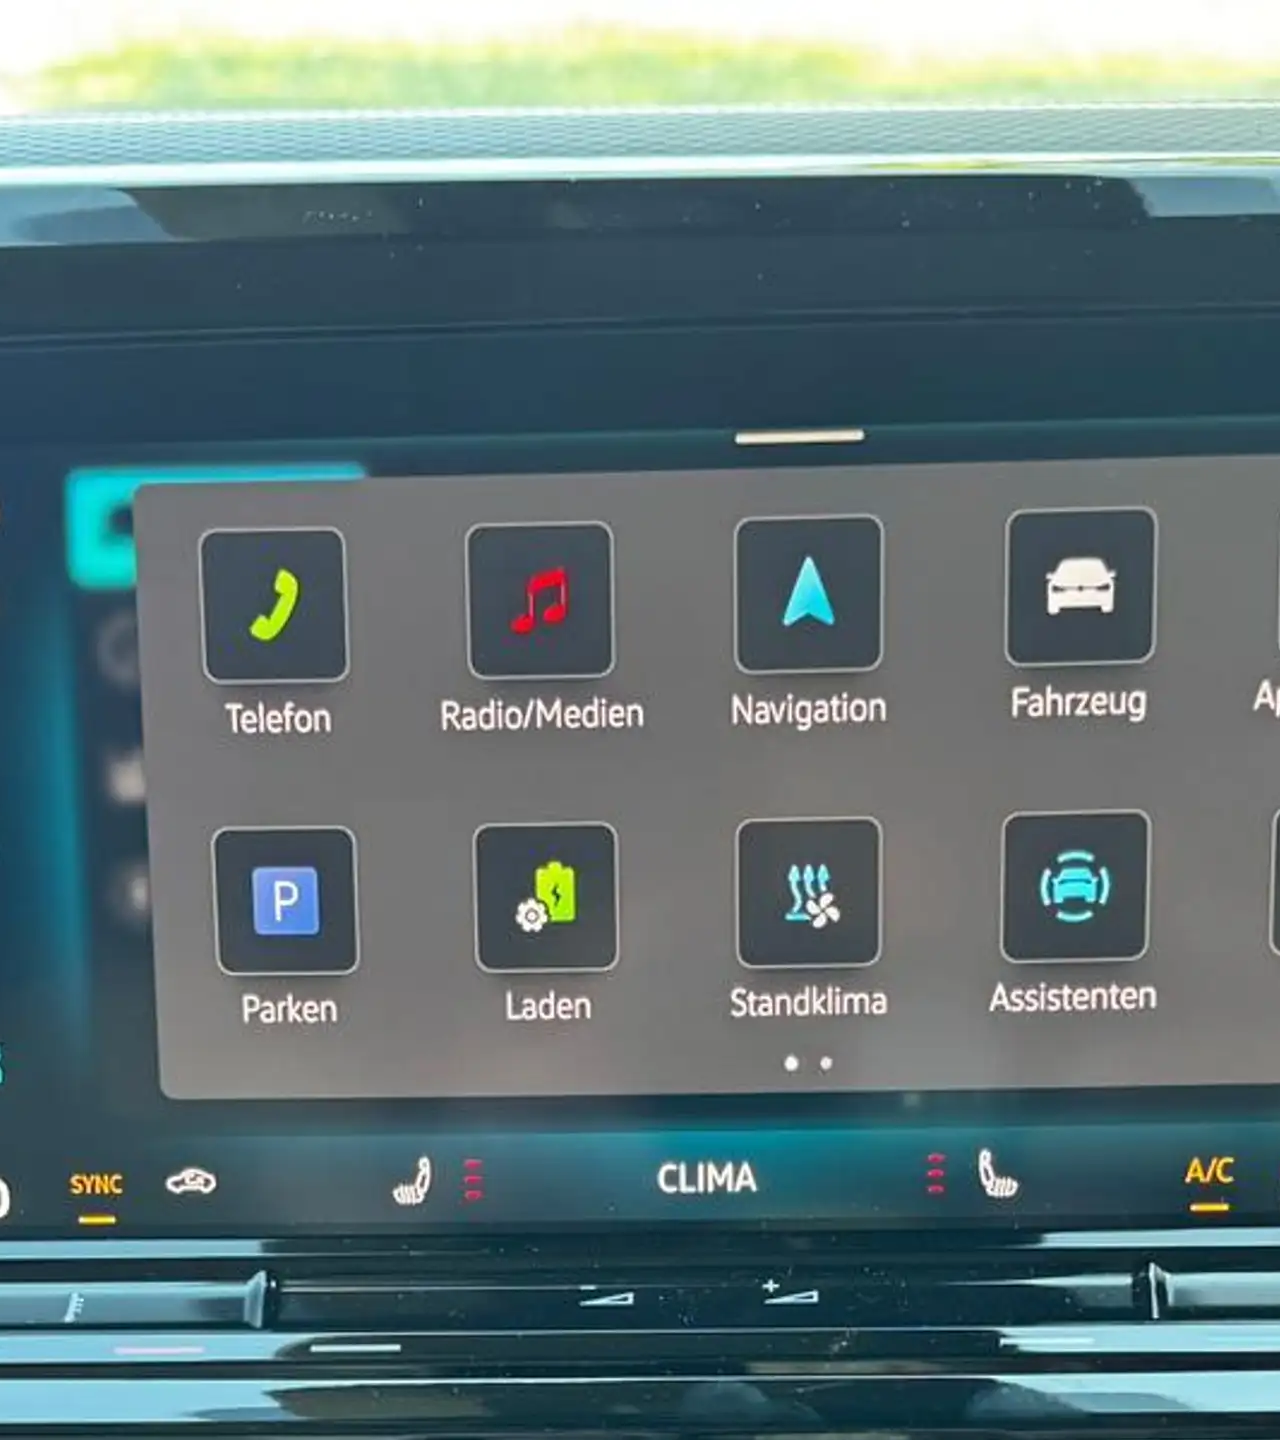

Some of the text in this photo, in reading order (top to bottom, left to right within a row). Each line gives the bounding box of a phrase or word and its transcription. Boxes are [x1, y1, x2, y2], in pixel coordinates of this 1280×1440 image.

[224, 701, 332, 734] Telefon
[441, 696, 644, 731] Radio/Medien
[732, 691, 887, 732] Navigation
[1011, 684, 1147, 723] Fahrzeug
[273, 881, 300, 922] P
[242, 993, 338, 1024] Parken
[506, 990, 592, 1021] Laden
[730, 985, 888, 1018] Standklima
[989, 982, 1157, 1013] Assistenten
[70, 1173, 123, 1195] SYNC
[656, 1160, 758, 1194] CLIMA
[1185, 1156, 1234, 1183] A/C
